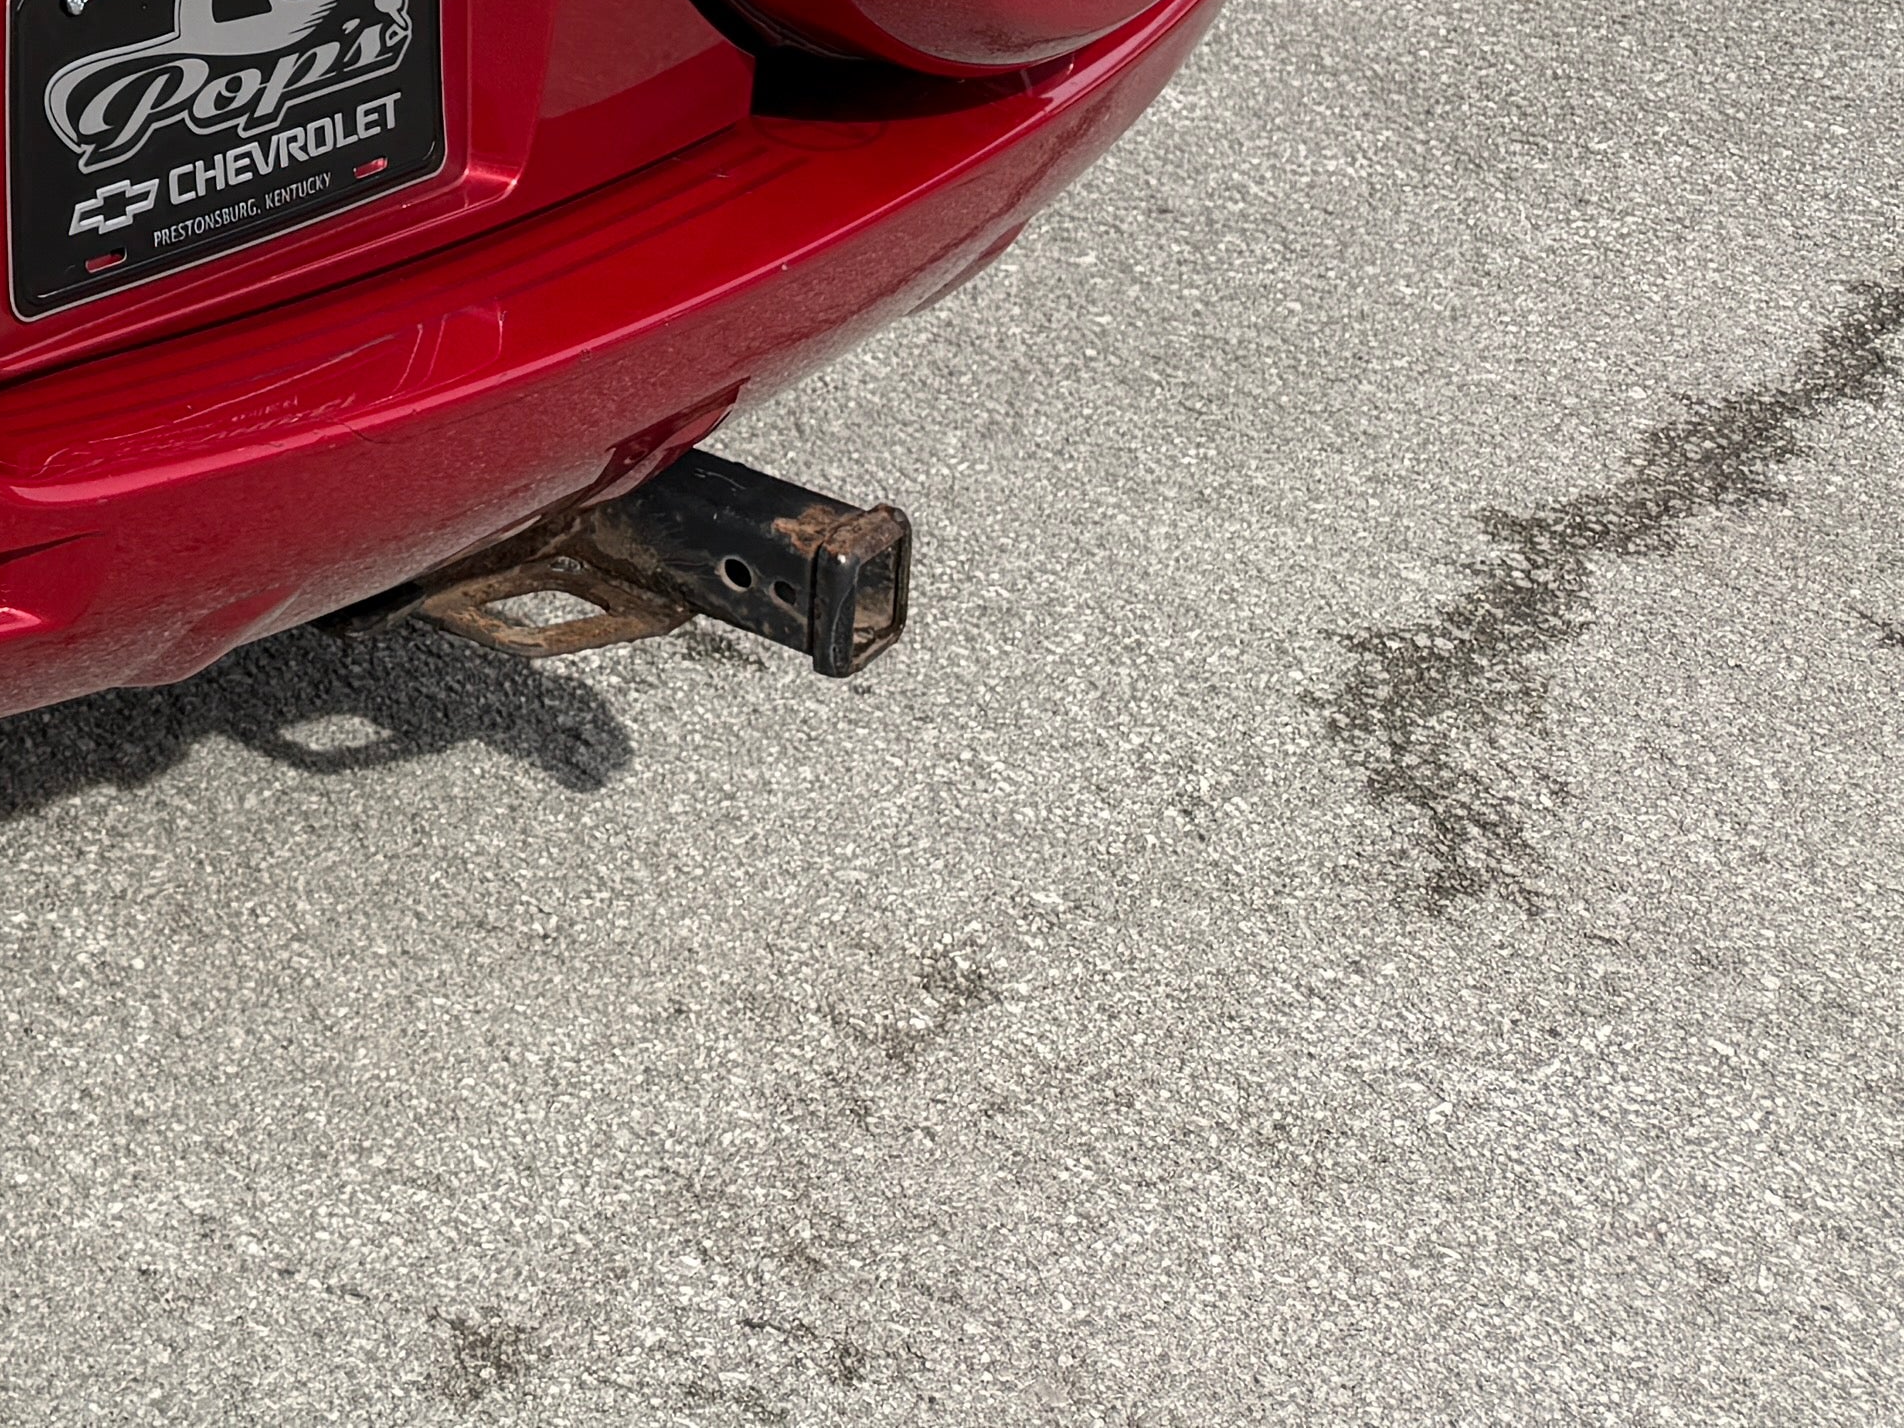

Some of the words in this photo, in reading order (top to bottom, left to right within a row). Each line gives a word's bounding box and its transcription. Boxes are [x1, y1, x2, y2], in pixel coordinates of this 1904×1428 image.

[77, 17, 394, 153] Pop's
[168, 93, 402, 206] CHEVROLET
[153, 198, 262, 248] PRESTONSBURG,
[265, 172, 333, 210] KENTUCKY
